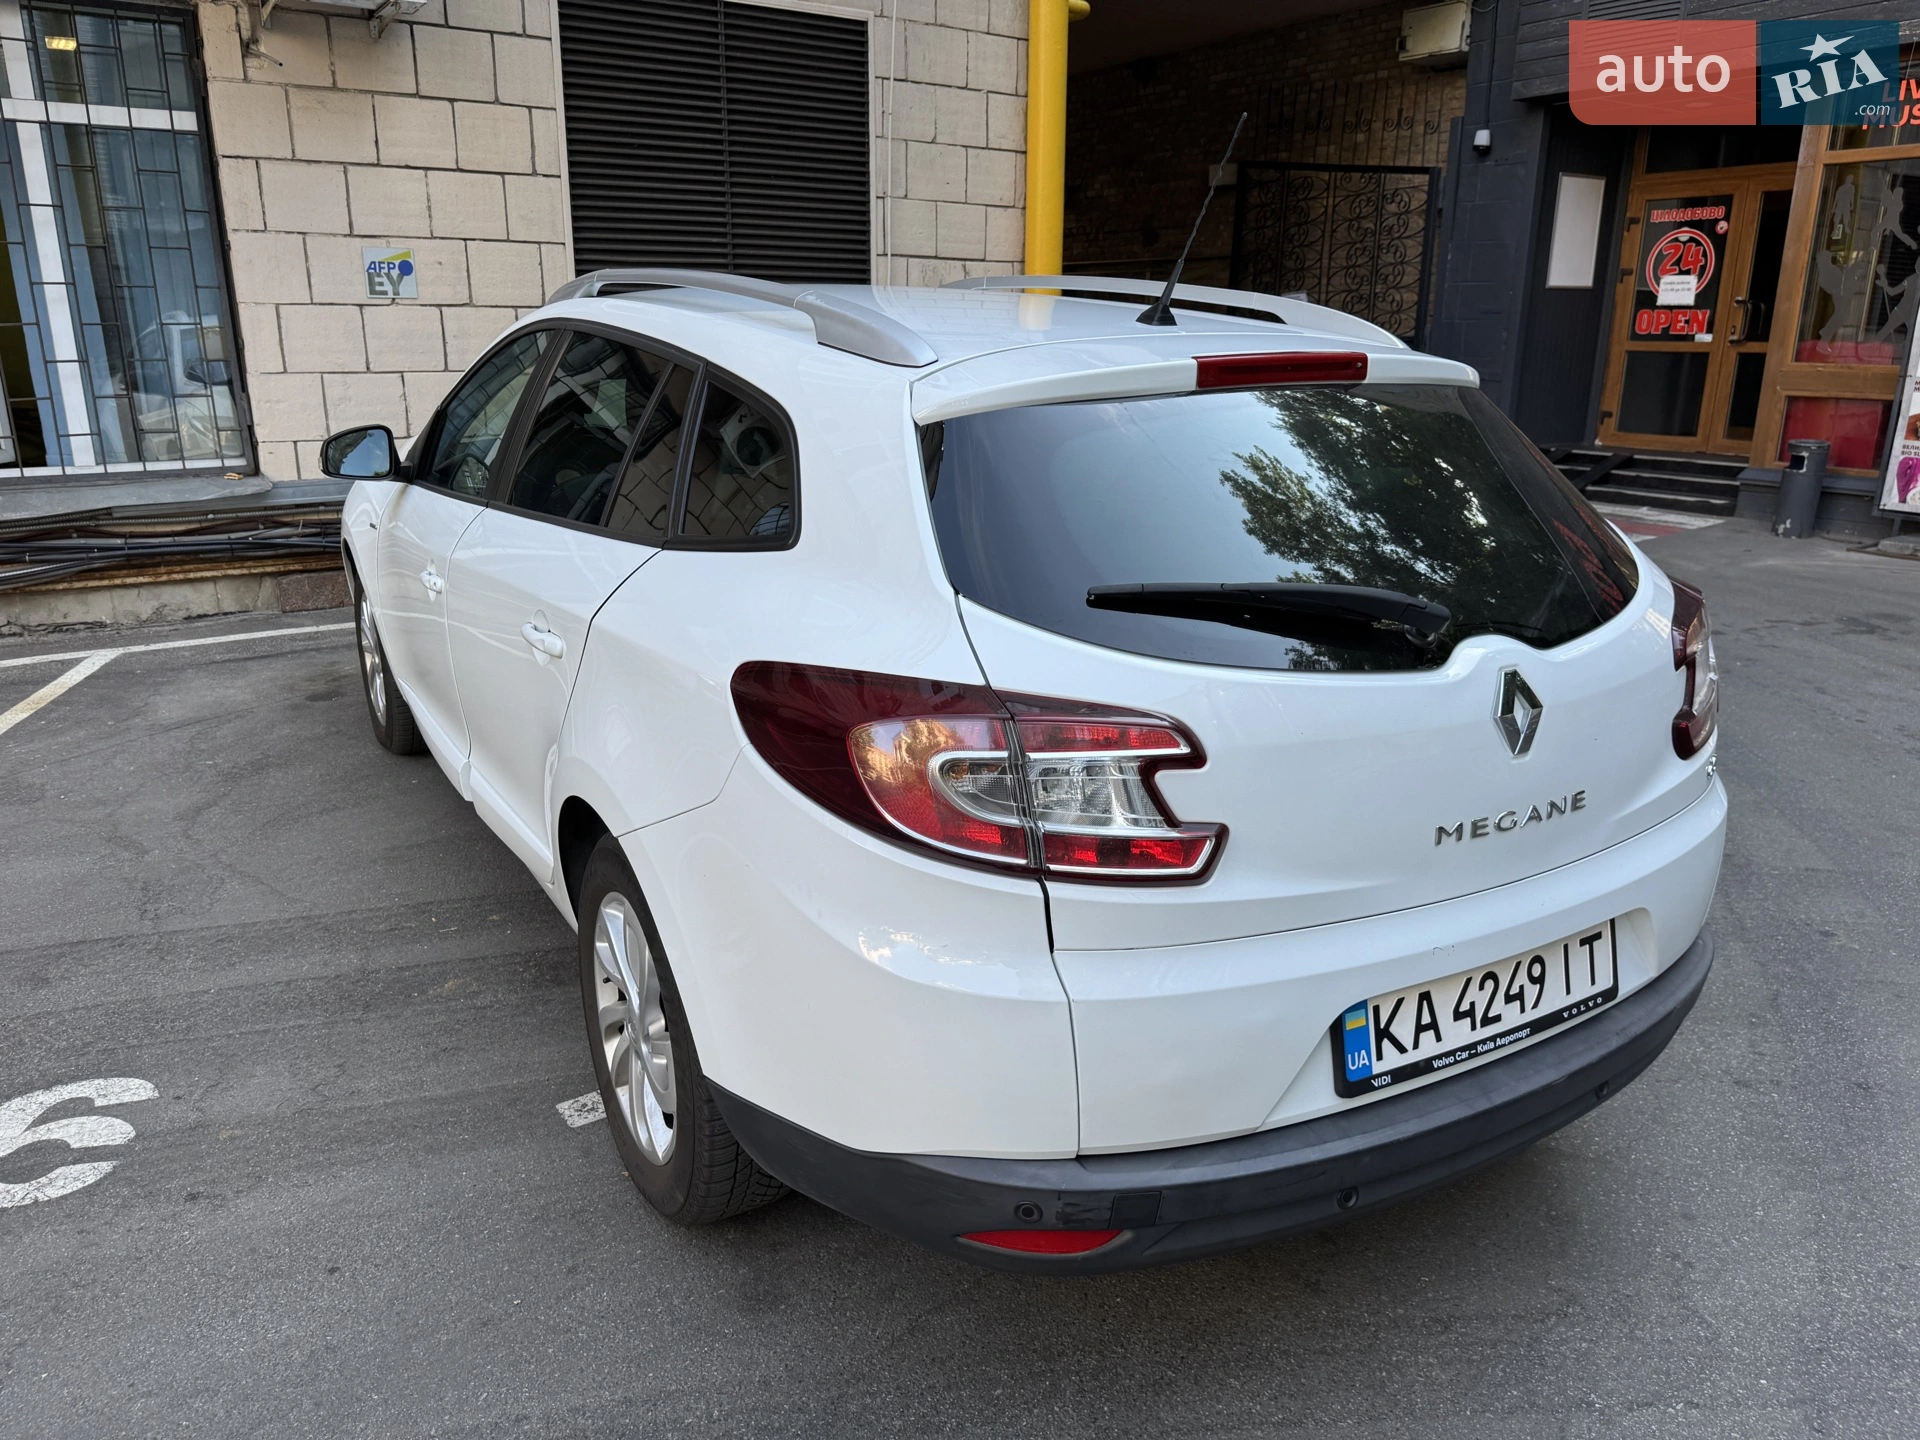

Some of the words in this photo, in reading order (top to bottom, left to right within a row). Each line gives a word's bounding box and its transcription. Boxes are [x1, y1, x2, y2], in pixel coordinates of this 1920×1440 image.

[1650, 206, 1725, 222] ЦІЛОДОБОВО
[366, 260, 396, 274] AFP
[1657, 242, 1704, 278] 24
[367, 272, 405, 296] EY
[1635, 309, 1709, 335] OPEN
[1434, 789, 1587, 847] MEGANE
[1372, 990, 1443, 1062] KA
[1452, 954, 1547, 1032] 4249
[1562, 930, 1603, 996] IT
[1562, 996, 1603, 1018] VOLVO
[1347, 1049, 1370, 1071] UA
[1432, 1055, 1455, 1069] Volvo
[1455, 1050, 1470, 1061] Car
[1477, 1041, 1495, 1054] Київ
[1496, 1027, 1531, 1046] Аеропорт
[1371, 1074, 1391, 1087] VIDI
